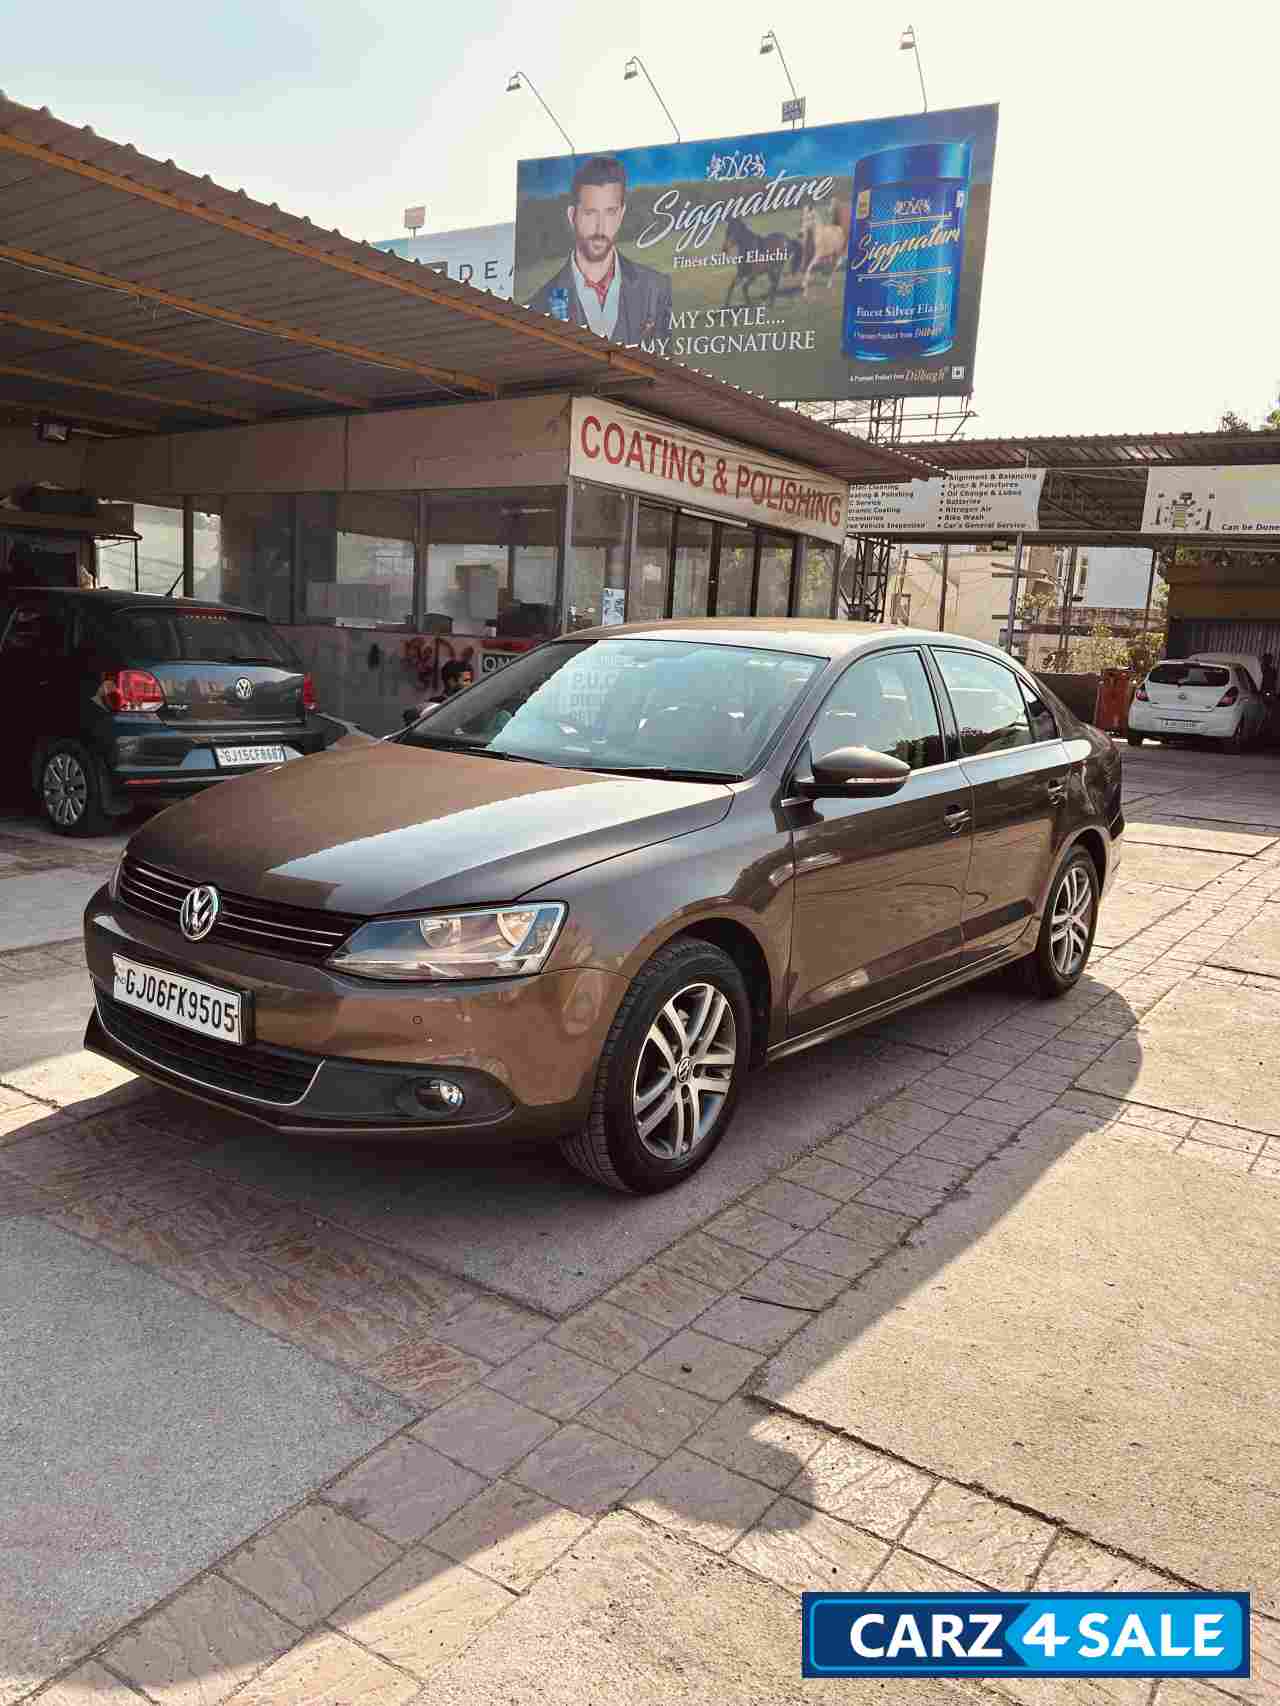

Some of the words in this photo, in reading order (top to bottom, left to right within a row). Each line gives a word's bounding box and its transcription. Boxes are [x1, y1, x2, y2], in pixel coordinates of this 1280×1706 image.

[636, 169, 833, 252] Siggnature
[673, 255, 707, 269] Finest
[710, 252, 743, 267] Silver
[745, 246, 789, 265] Elaichi
[668, 310, 700, 330] MY
[674, 330, 816, 356] SIGGNATURE
[580, 415, 705, 488] COATING
[712, 458, 729, 496] &
[736, 464, 842, 527] POLISHING
[949, 471, 986, 481] Alignment
[963, 513, 984, 521] Wash
[980, 505, 992, 513] Air
[1222, 523, 1239, 531] Can
[125, 968, 236, 1033] GJ06FK9505
